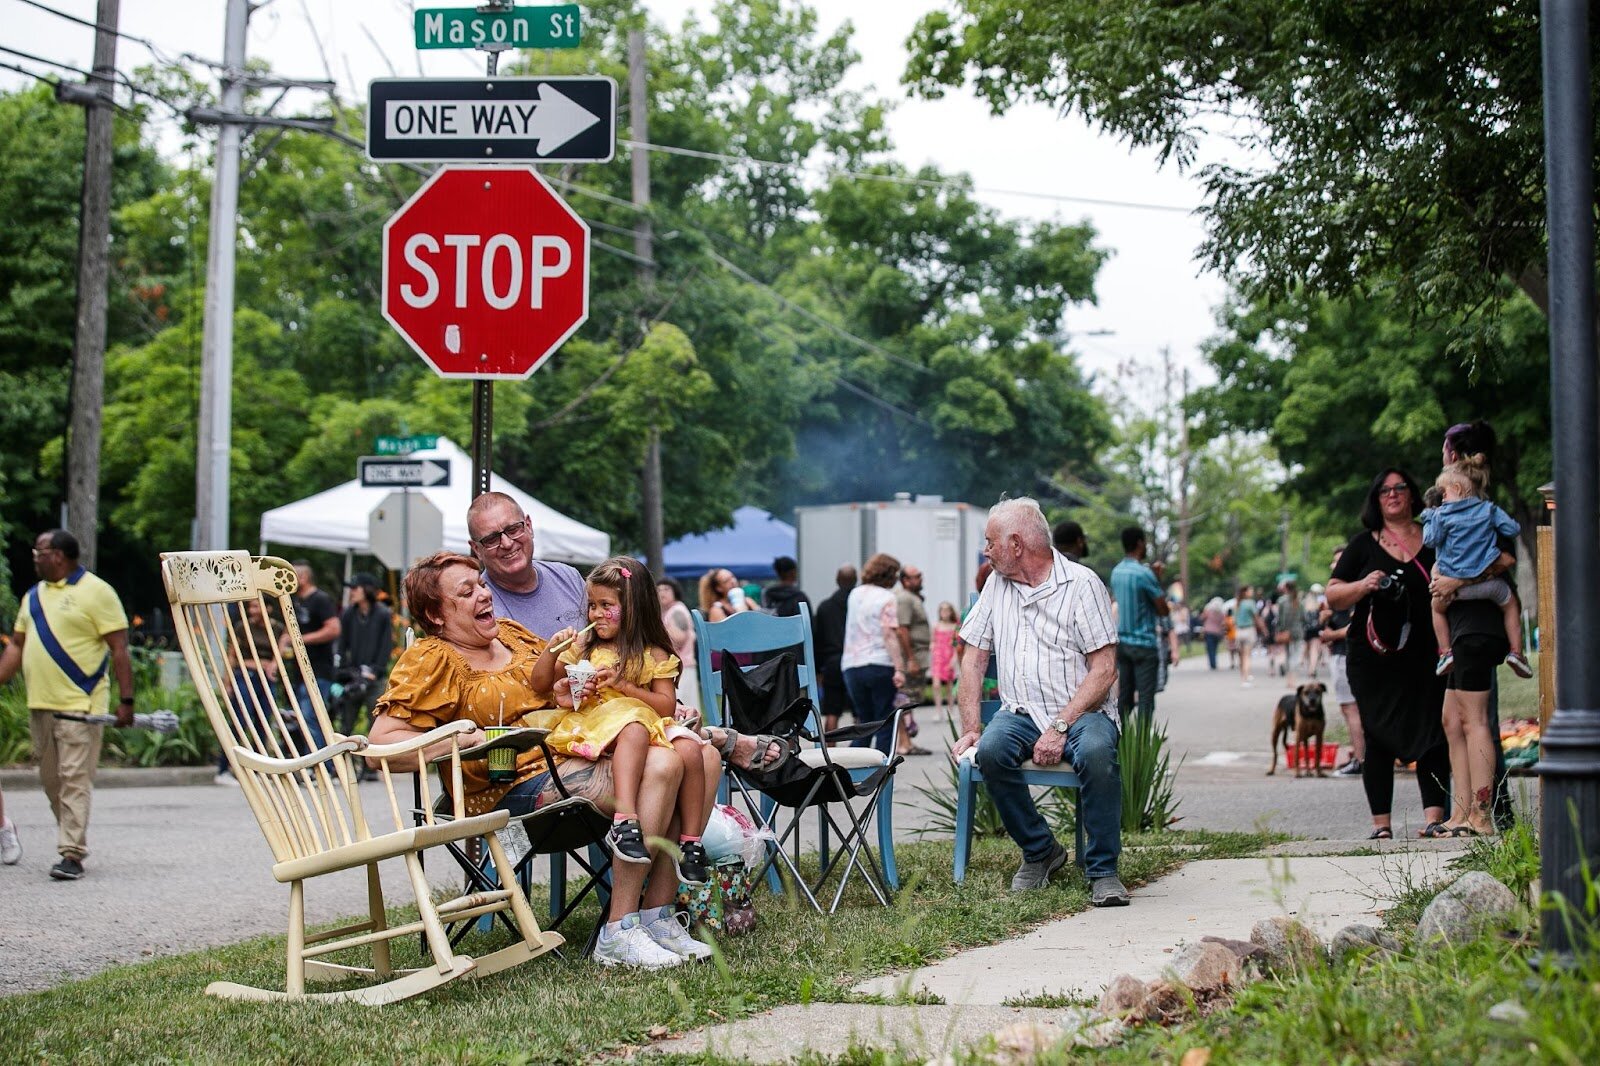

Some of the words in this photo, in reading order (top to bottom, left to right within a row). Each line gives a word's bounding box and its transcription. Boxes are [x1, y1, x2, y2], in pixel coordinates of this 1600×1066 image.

[425, 13, 528, 43] Mason
[550, 13, 574, 38] St
[395, 105, 457, 134] ONE
[472, 105, 537, 134] WAY
[400, 233, 572, 310] STOP
